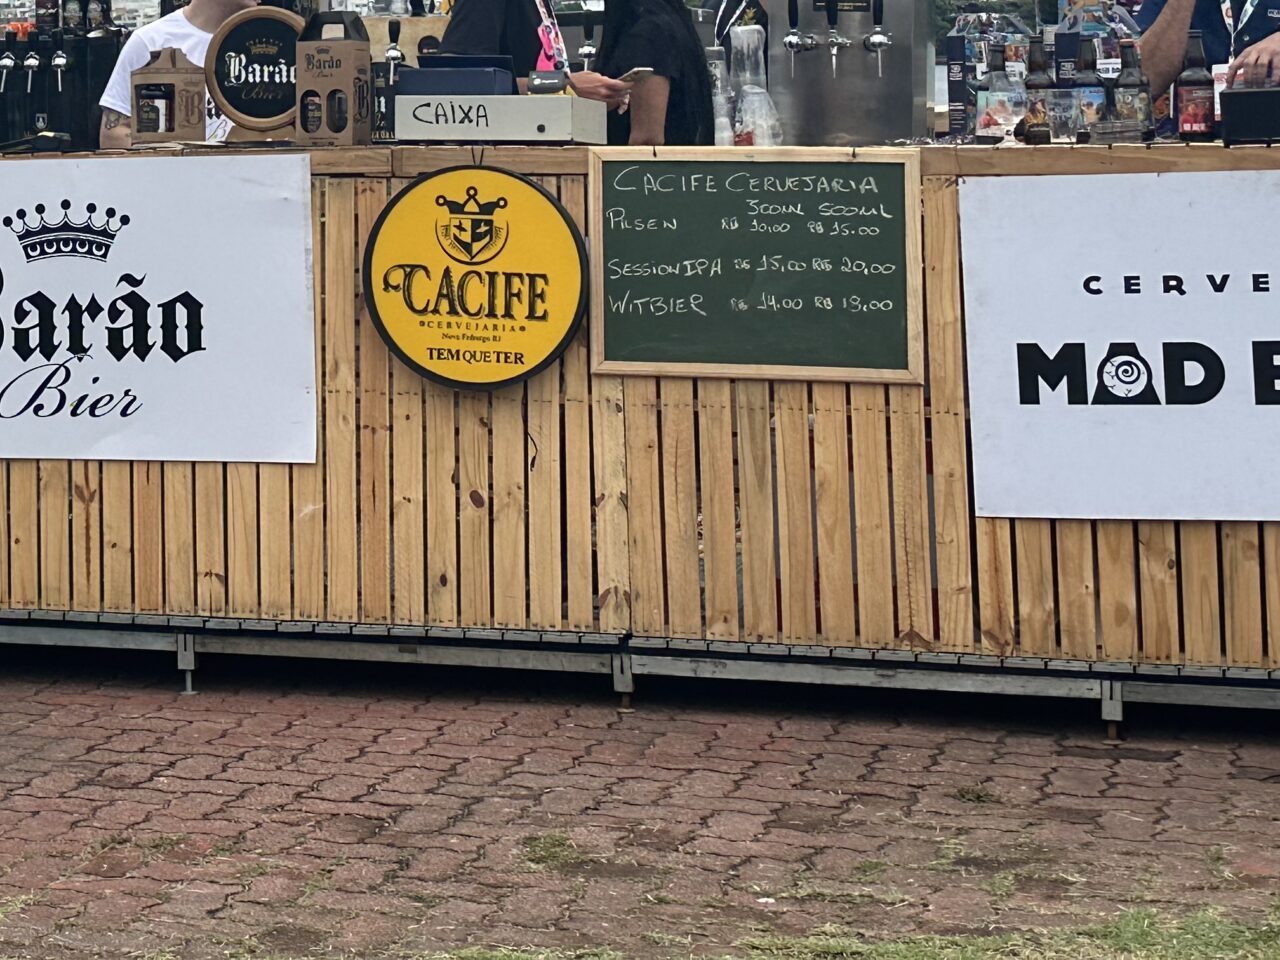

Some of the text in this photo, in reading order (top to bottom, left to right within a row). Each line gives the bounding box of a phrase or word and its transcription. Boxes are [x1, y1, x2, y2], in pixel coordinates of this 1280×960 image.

[613, 166, 878, 195] CACIFE CERVEJARIA
[606, 208, 677, 231] PILSEN
[383, 264, 549, 322] CACIFE
[608, 290, 707, 317] WITBIER
[427, 321, 516, 332] CERVEJARIA
[427, 347, 525, 365] TEM QUE TER
